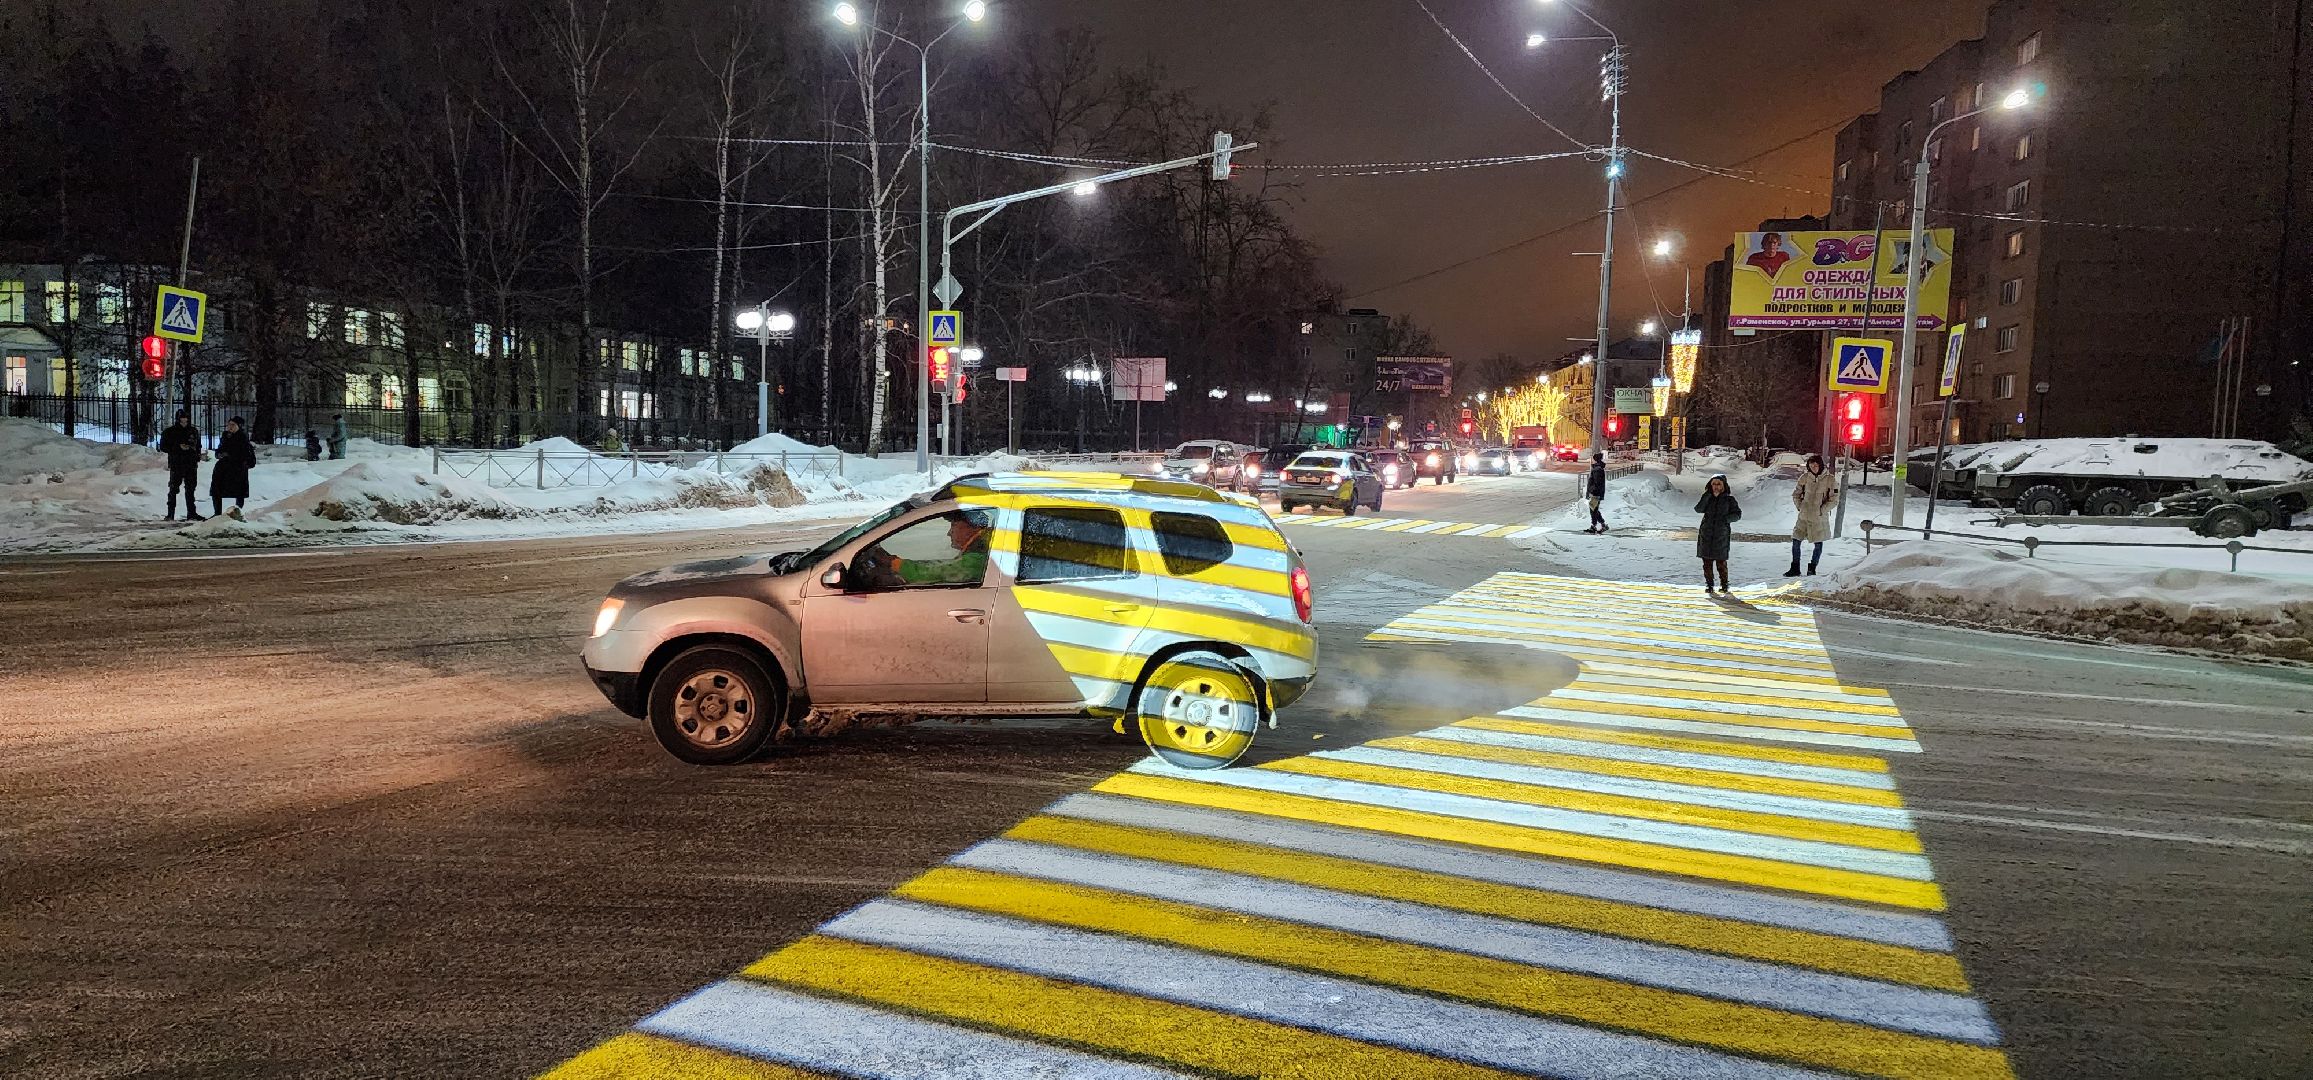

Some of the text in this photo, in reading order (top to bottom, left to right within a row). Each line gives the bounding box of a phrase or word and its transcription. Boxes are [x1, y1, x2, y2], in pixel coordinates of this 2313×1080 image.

[1773, 287, 1907, 301] ДЛЯ СТИЛЬНЫХ
[1764, 303, 1833, 314] ПОДРОСТКОВ
[1839, 303, 1847, 314] И
[1376, 380, 1400, 392] 24/7
[1616, 389, 1643, 397] ОКНА
